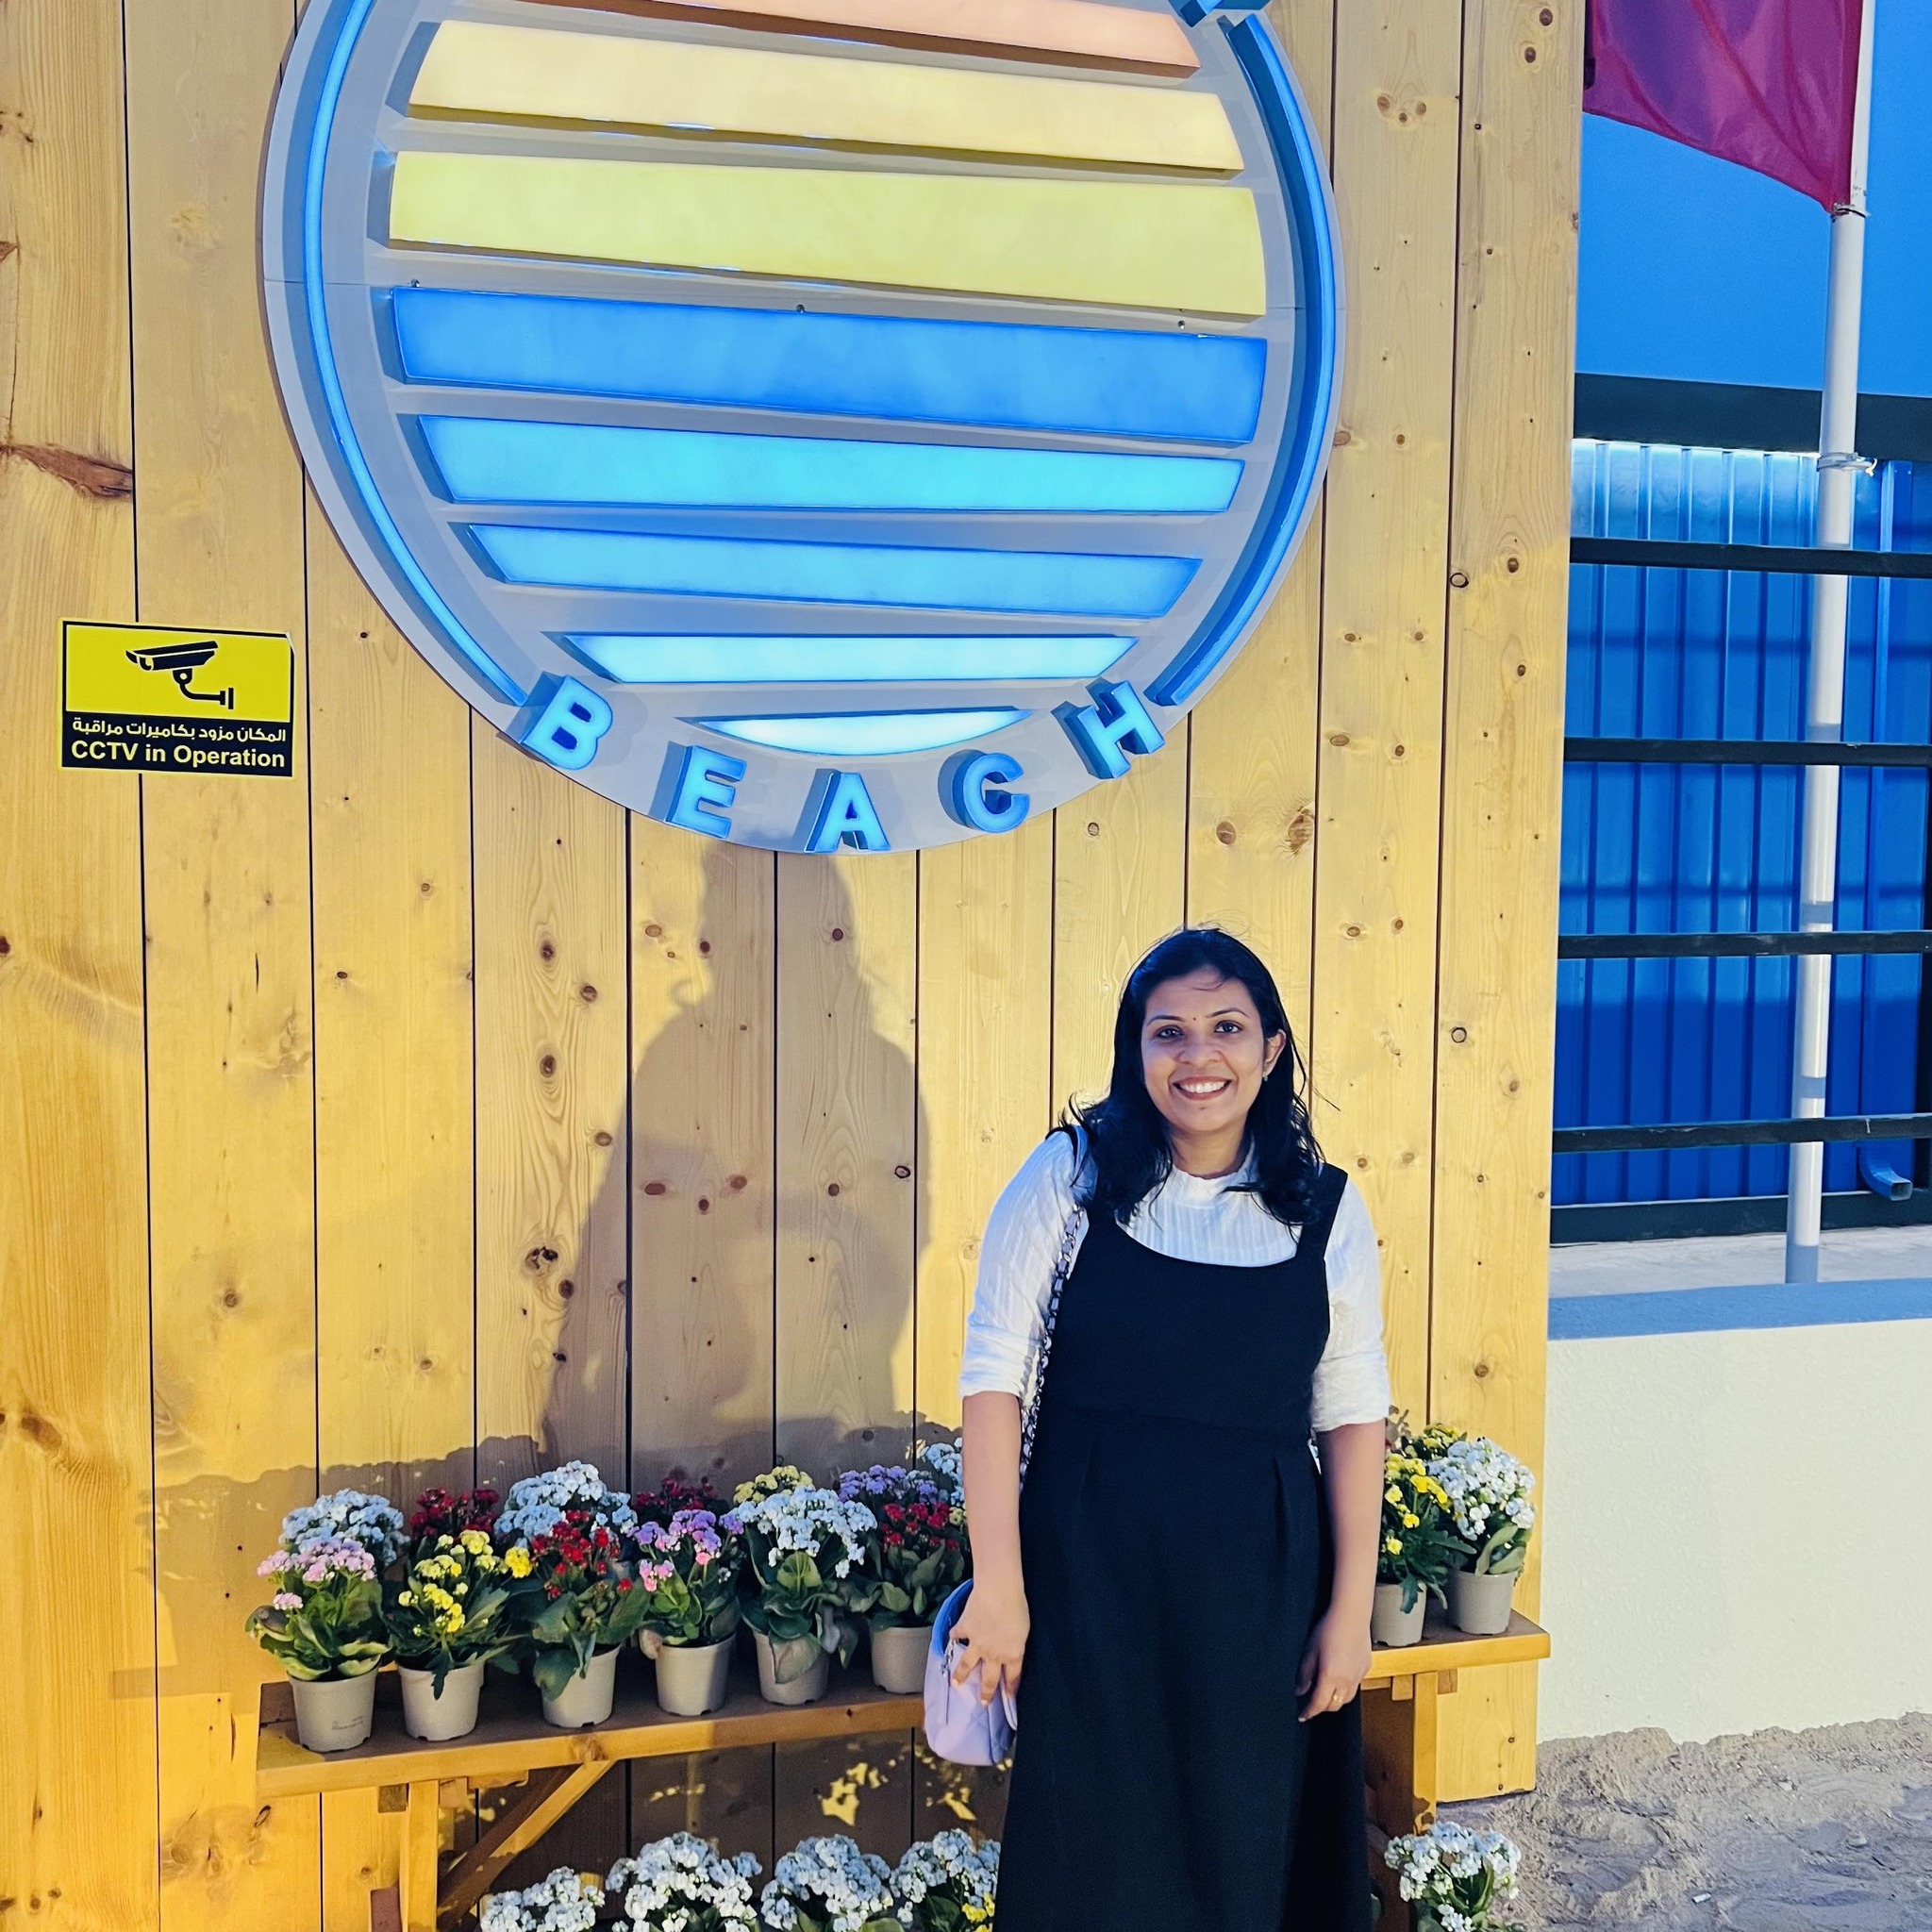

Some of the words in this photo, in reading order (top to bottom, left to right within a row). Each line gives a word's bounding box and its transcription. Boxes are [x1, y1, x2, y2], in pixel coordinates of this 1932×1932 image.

[72, 717, 124, 736] مراقبة
[125, 722, 196, 741] بكاميرات
[198, 725, 235, 741] مزود
[237, 726, 286, 742] المكان
[71, 740, 139, 760] CCTV
[145, 743, 166, 762] in
[173, 744, 285, 768] Operation
[521, 675, 1166, 853] BEACH
